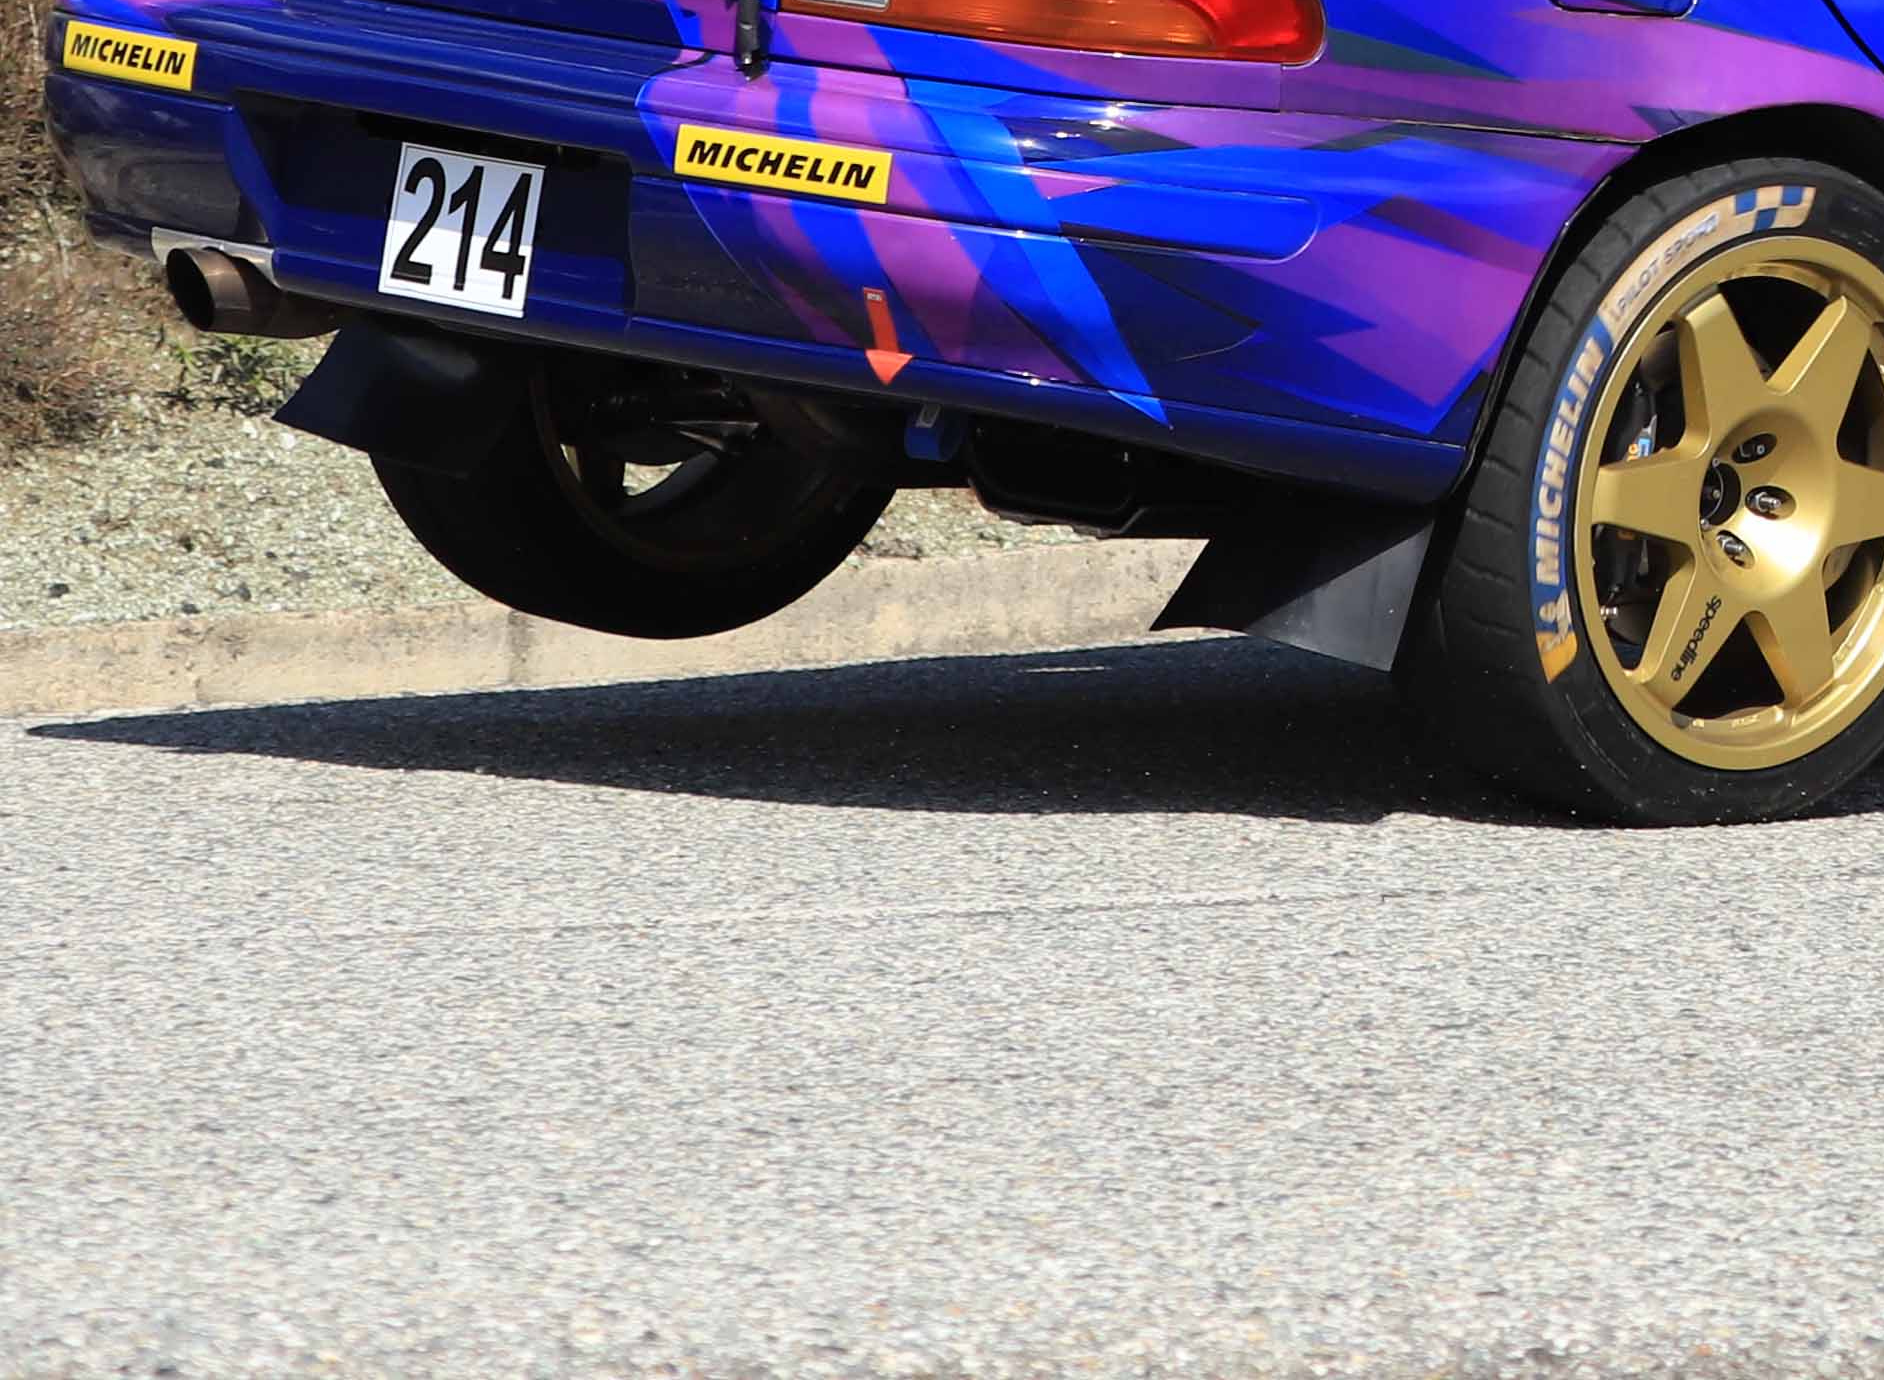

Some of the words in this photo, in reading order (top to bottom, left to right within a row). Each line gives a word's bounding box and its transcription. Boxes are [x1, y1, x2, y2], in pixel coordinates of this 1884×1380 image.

[69, 31, 187, 77] MICHELIN
[686, 139, 876, 189] MICHELIN
[389, 156, 533, 300] 214
[1616, 256, 1660, 315] PILOT
[1535, 336, 1605, 587] MICHELIN
[1671, 595, 1722, 681] speedline
